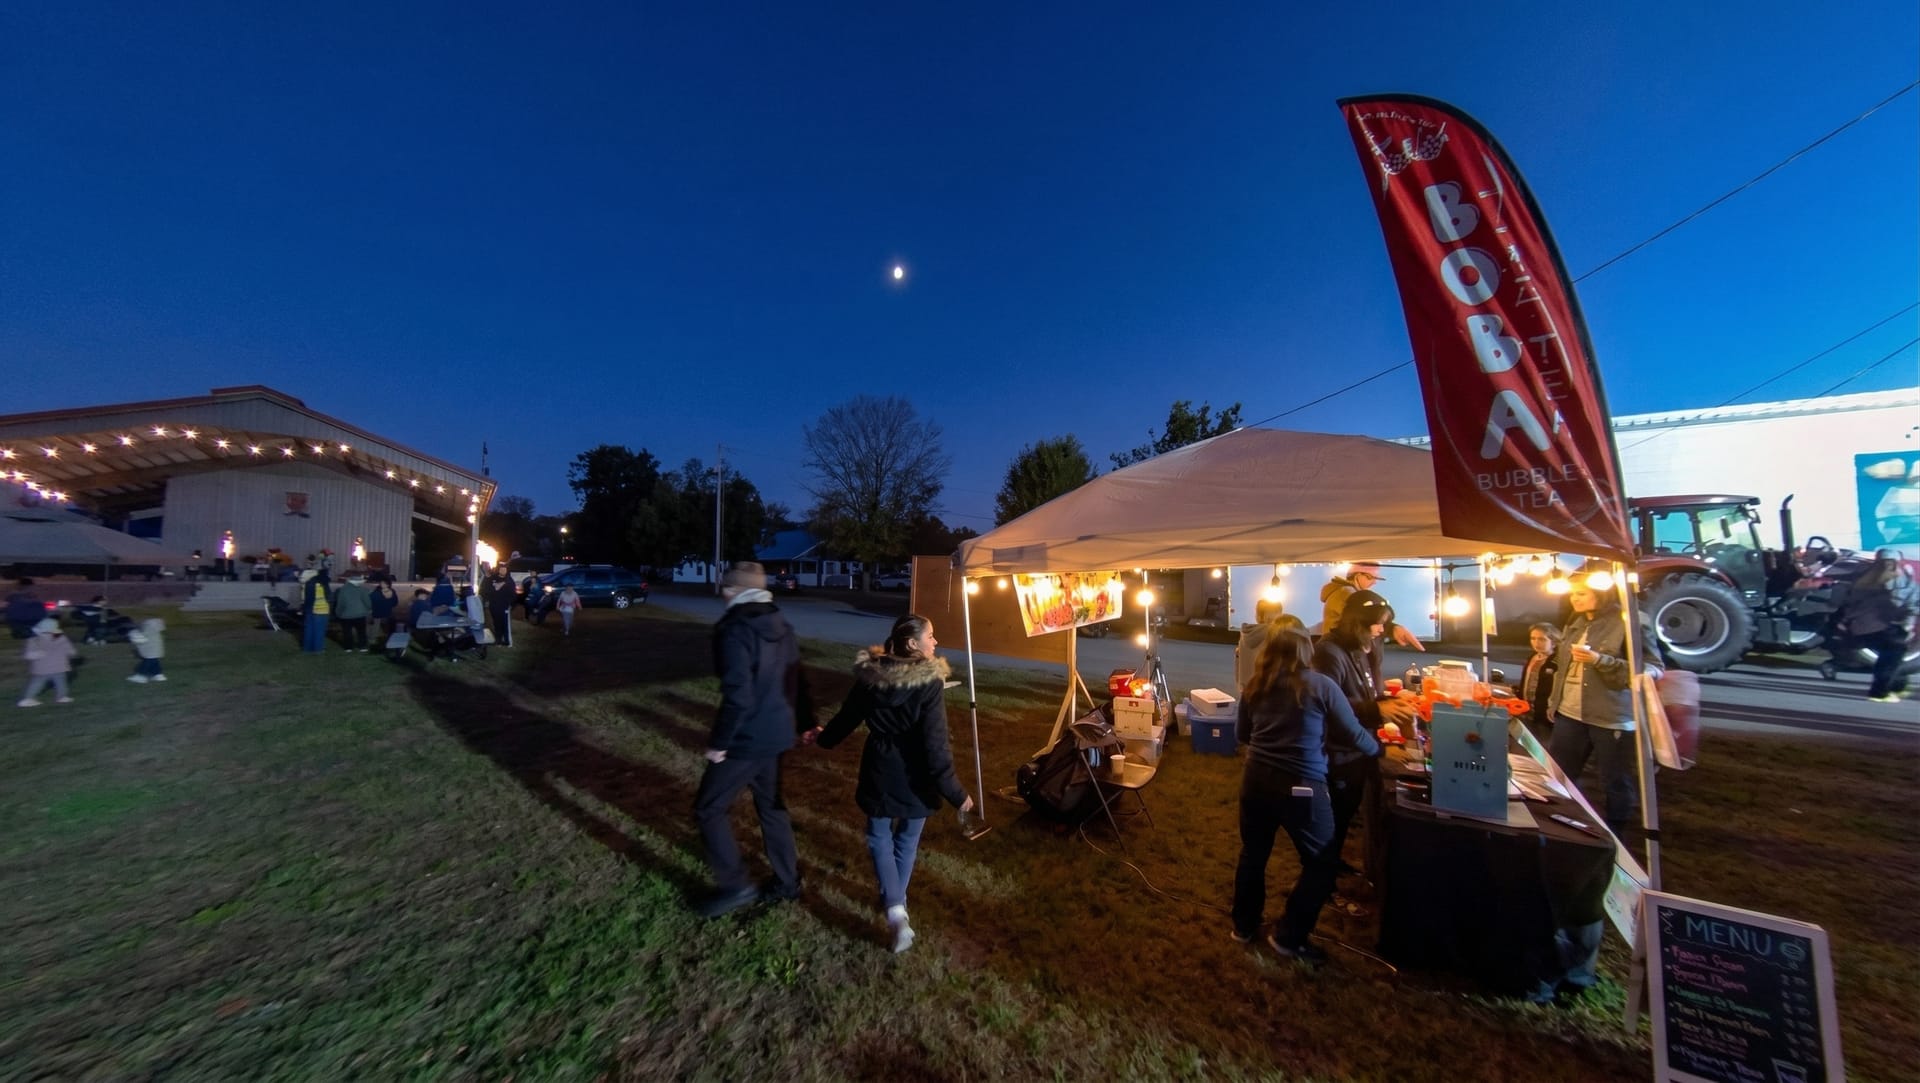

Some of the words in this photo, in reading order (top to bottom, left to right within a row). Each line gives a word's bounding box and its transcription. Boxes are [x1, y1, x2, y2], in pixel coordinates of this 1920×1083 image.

[1424, 180, 1550, 460] BOBA
[1477, 463, 1579, 491] BUBBLE
[1512, 489, 1565, 510] TEA
[1685, 915, 1772, 957] MENU
